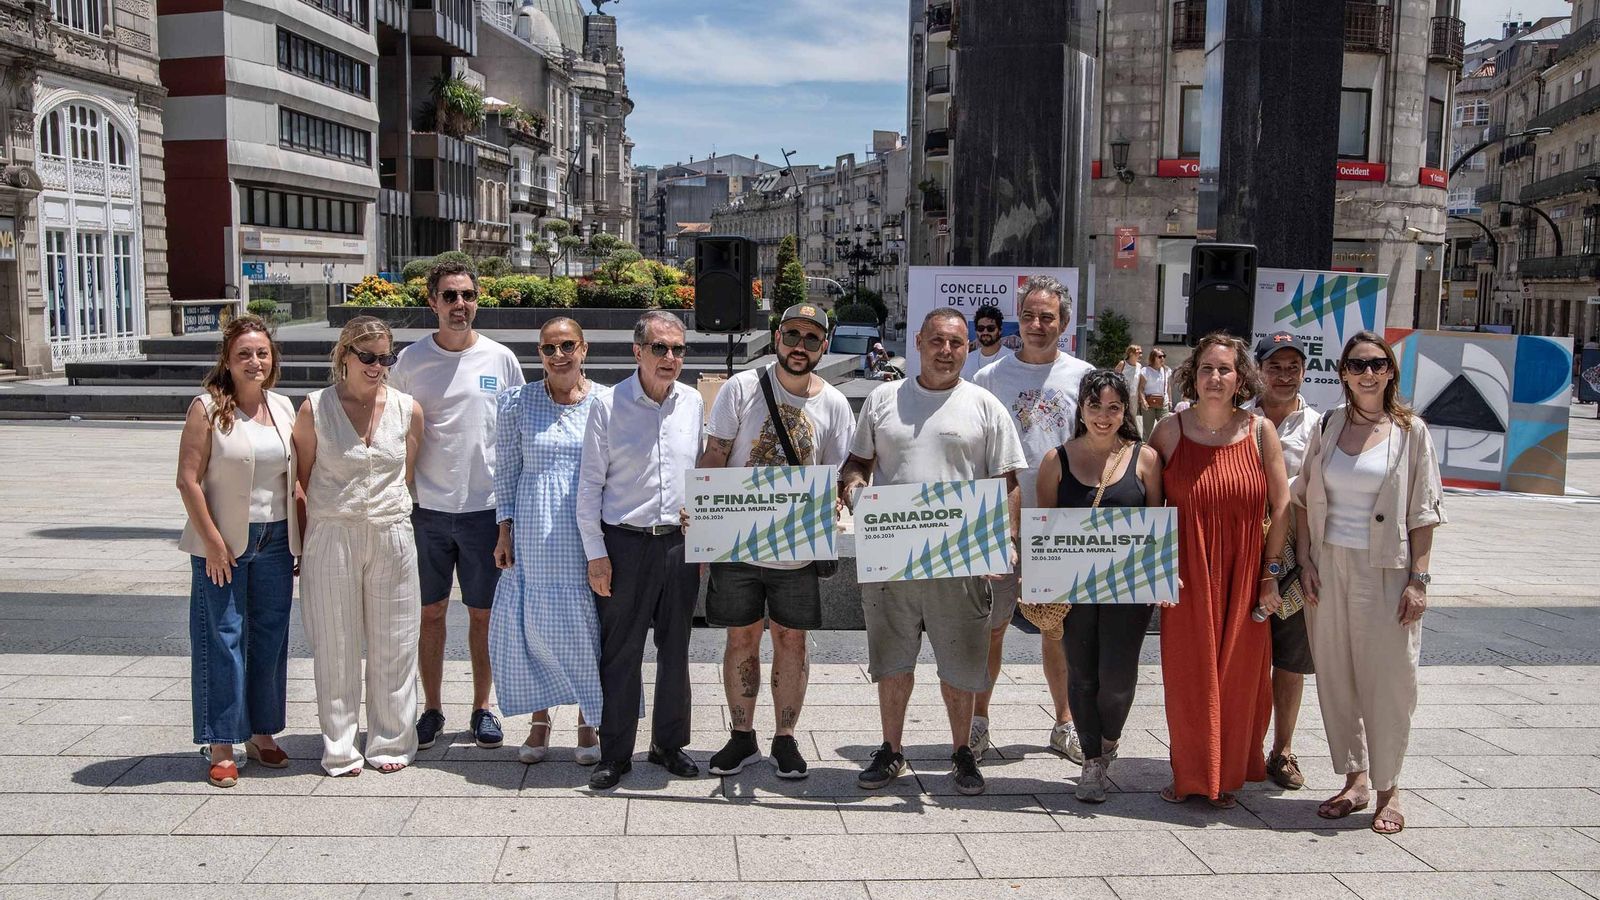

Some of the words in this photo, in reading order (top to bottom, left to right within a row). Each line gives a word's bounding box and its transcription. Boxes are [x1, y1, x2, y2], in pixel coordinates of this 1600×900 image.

[1340, 167, 1370, 176] Occident
[940, 283, 1007, 294] CONCELLO
[948, 296, 964, 306] DE
[969, 296, 999, 306] VIGO
[713, 492, 815, 505] FINALISTA
[863, 508, 963, 525] GANADOR
[1054, 534, 1158, 546] FINALISTA
